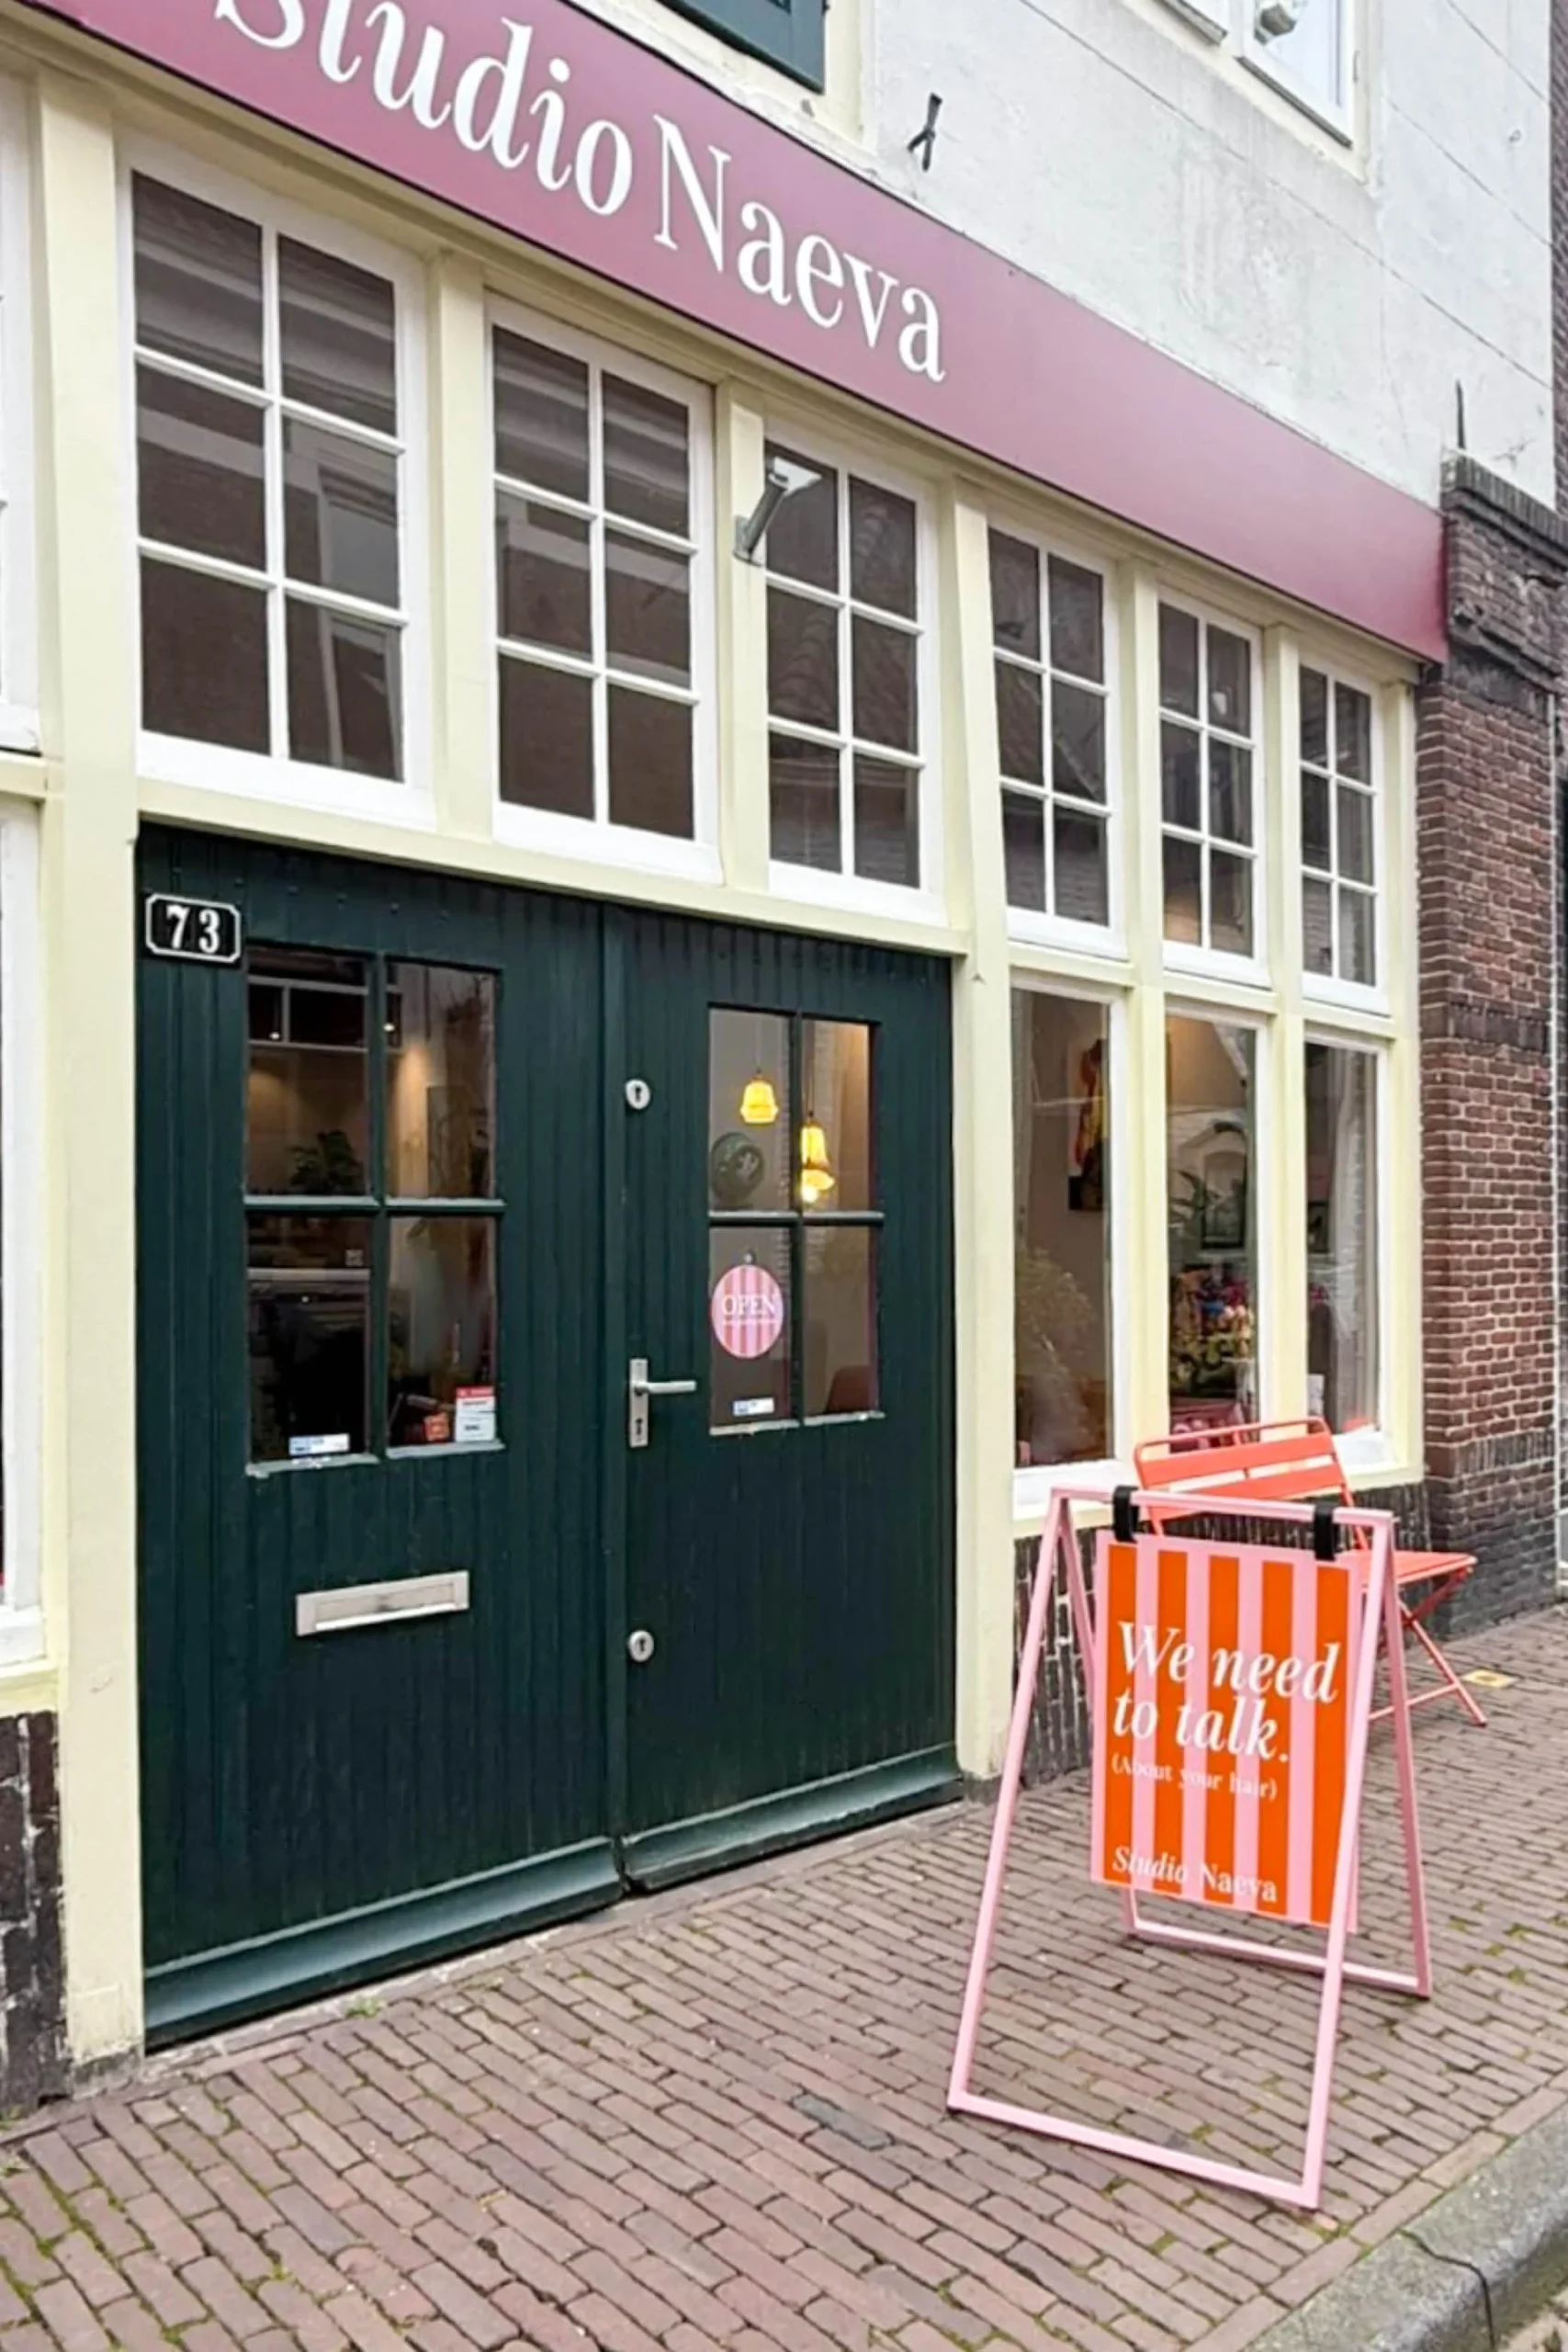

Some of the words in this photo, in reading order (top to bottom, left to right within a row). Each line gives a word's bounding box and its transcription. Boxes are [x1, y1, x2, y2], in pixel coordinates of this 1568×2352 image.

[215, 0, 632, 216] tudio
[653, 114, 946, 382] Naeva
[166, 905, 220, 955] 73
[721, 1294, 776, 1316] OPEN
[1118, 1621, 1194, 1682] We
[1212, 1641, 1342, 1703] need
[1113, 1688, 1158, 1739] to
[1176, 1695, 1288, 1762] talk.
[1111, 1752, 1172, 1782] (About
[1178, 1766, 1223, 1790] your
[1229, 1771, 1278, 1802] hair)
[1112, 1845, 1189, 1883] Studio
[1200, 1861, 1278, 1903] Naeva
